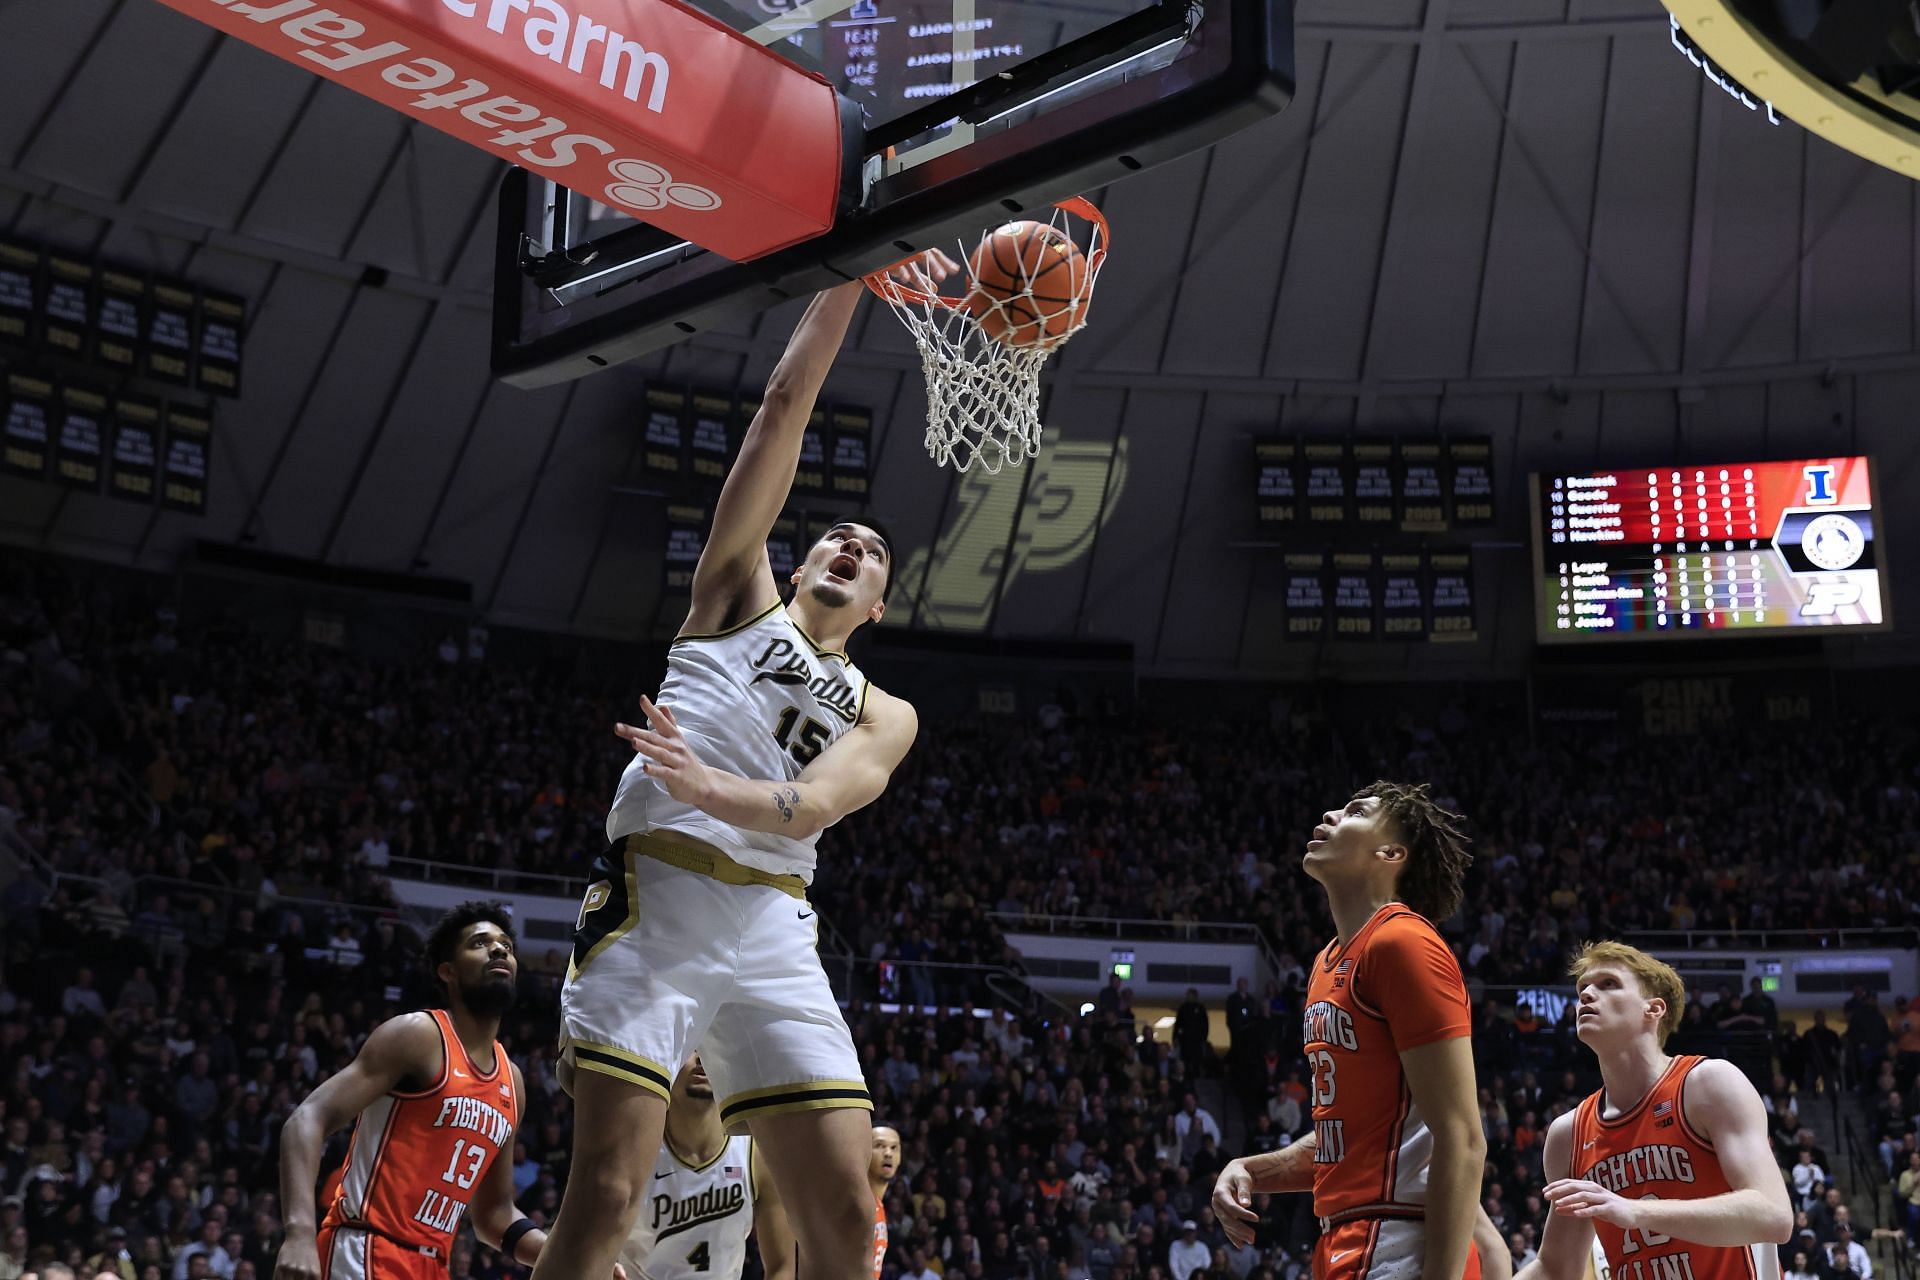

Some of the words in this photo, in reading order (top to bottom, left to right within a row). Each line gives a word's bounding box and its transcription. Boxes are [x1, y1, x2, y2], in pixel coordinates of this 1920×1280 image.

[211, 0, 615, 168] StateFar
[1672, 472, 1680, 483] 2
[1696, 471, 1704, 482] 2
[1745, 482, 1753, 494] 2
[1552, 518, 1565, 529] 20
[1677, 513, 1683, 524] 1
[1725, 510, 1731, 522] 1
[1749, 509, 1755, 521] 1
[1652, 527, 1660, 539] 7
[1676, 526, 1684, 538] 2
[1726, 524, 1732, 535] 1
[1750, 523, 1756, 534] 1
[1701, 542, 1709, 551] A
[1749, 539, 1758, 549] F
[1678, 558, 1687, 569] 2
[1702, 557, 1711, 568] 2
[1726, 556, 1735, 567] 0
[1751, 555, 1759, 566] 0
[1728, 569, 1736, 581] 0
[1561, 591, 1568, 600] 4
[1654, 586, 1667, 598] 14
[1657, 600, 1665, 611] 2
[1682, 613, 1691, 624] 2
[1709, 612, 1715, 624] 1
[1733, 611, 1739, 623] 1
[1755, 610, 1764, 622] 2
[772, 706, 832, 766] 15
[442, 1138, 487, 1190] 13
[651, 1182, 745, 1232] Purdue
[686, 1241, 711, 1272] 4
